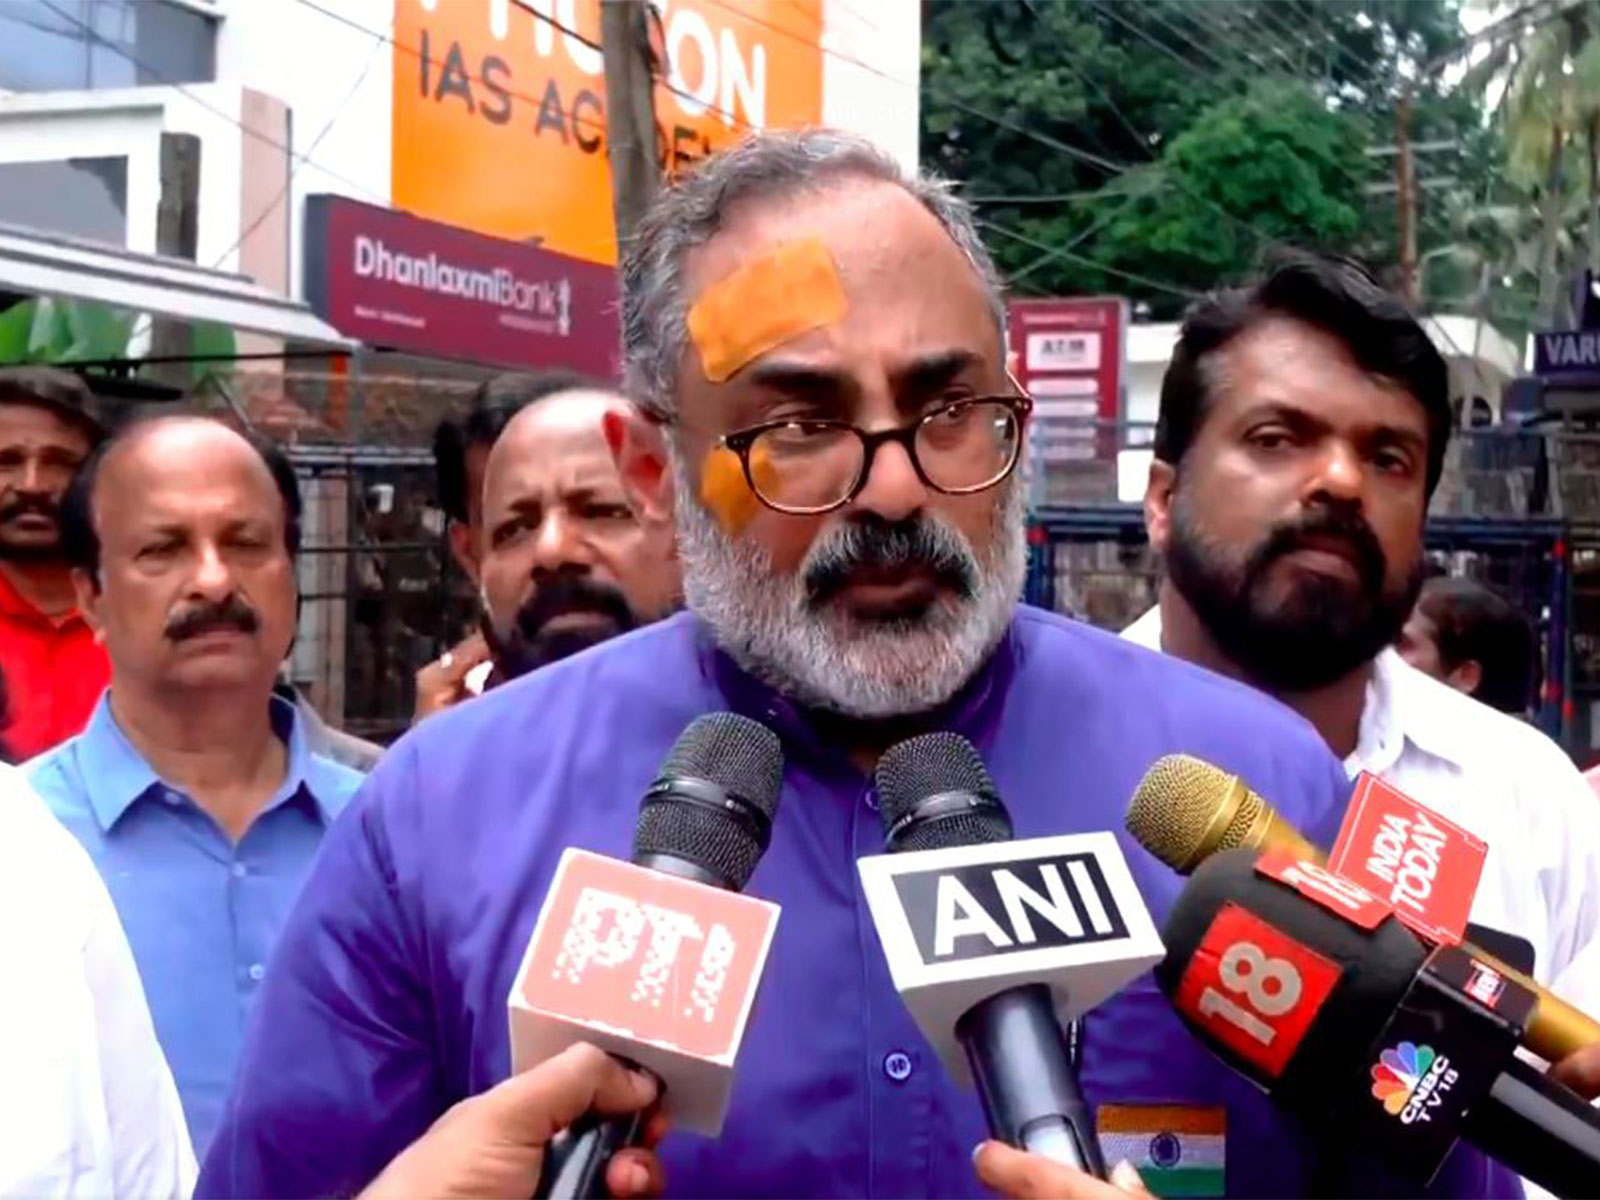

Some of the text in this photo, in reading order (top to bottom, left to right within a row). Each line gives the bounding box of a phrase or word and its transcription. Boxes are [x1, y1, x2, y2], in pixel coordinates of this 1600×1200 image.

[420, 29, 513, 126] IAS
[355, 234, 556, 314] DhanlaxmiBank
[1544, 334, 1600, 365] VAR
[1366, 814, 1411, 884] INDIA
[1390, 811, 1447, 912] TODAY
[934, 860, 1114, 956] ANI
[552, 887, 736, 1022] PTI
[1198, 942, 1304, 1047] 18
[1400, 1055, 1450, 1124] CNBC
[1416, 1068, 1459, 1122] TV18
